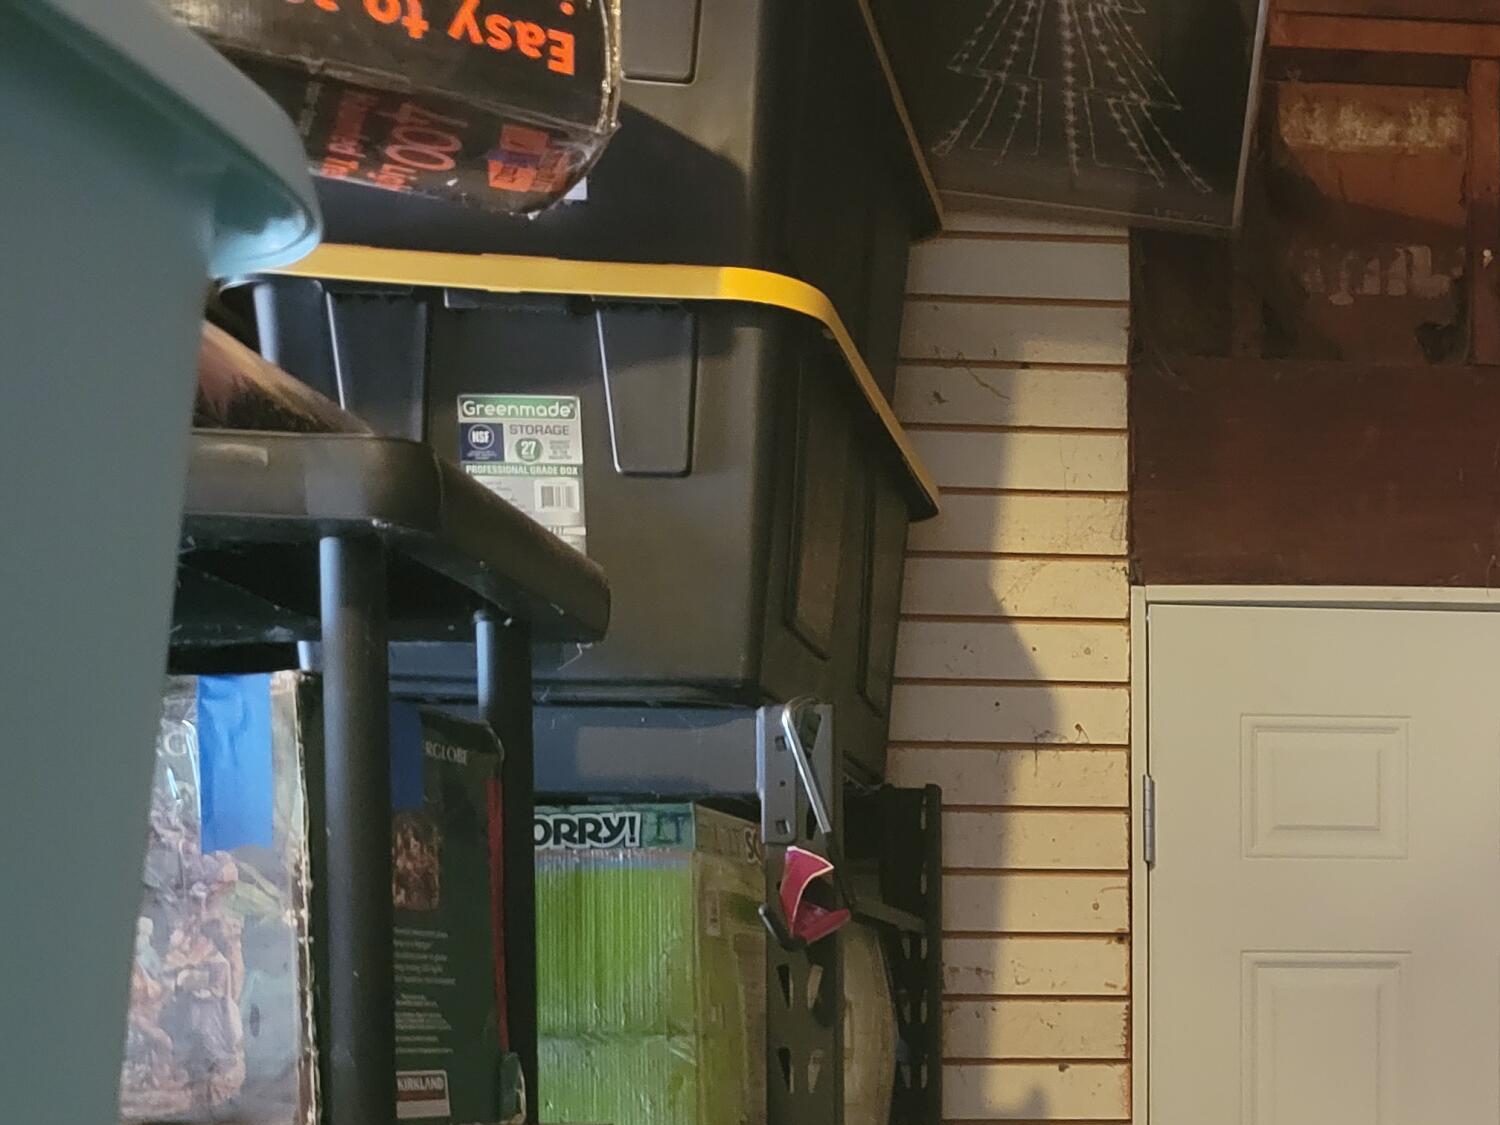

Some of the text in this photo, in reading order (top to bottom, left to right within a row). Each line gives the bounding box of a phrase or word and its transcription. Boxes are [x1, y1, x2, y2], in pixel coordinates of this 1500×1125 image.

[448, 0, 575, 76] Easy
[462, 400, 571, 418] Greenmade
[472, 430, 490, 444] NSF
[509, 424, 571, 436] STORAGE
[521, 440, 537, 455] 27
[465, 464, 579, 476] PROFESSIONAL GRADE BOX
[534, 813, 640, 849] ORRY!
[397, 1076, 444, 1091] KIRKLAND
